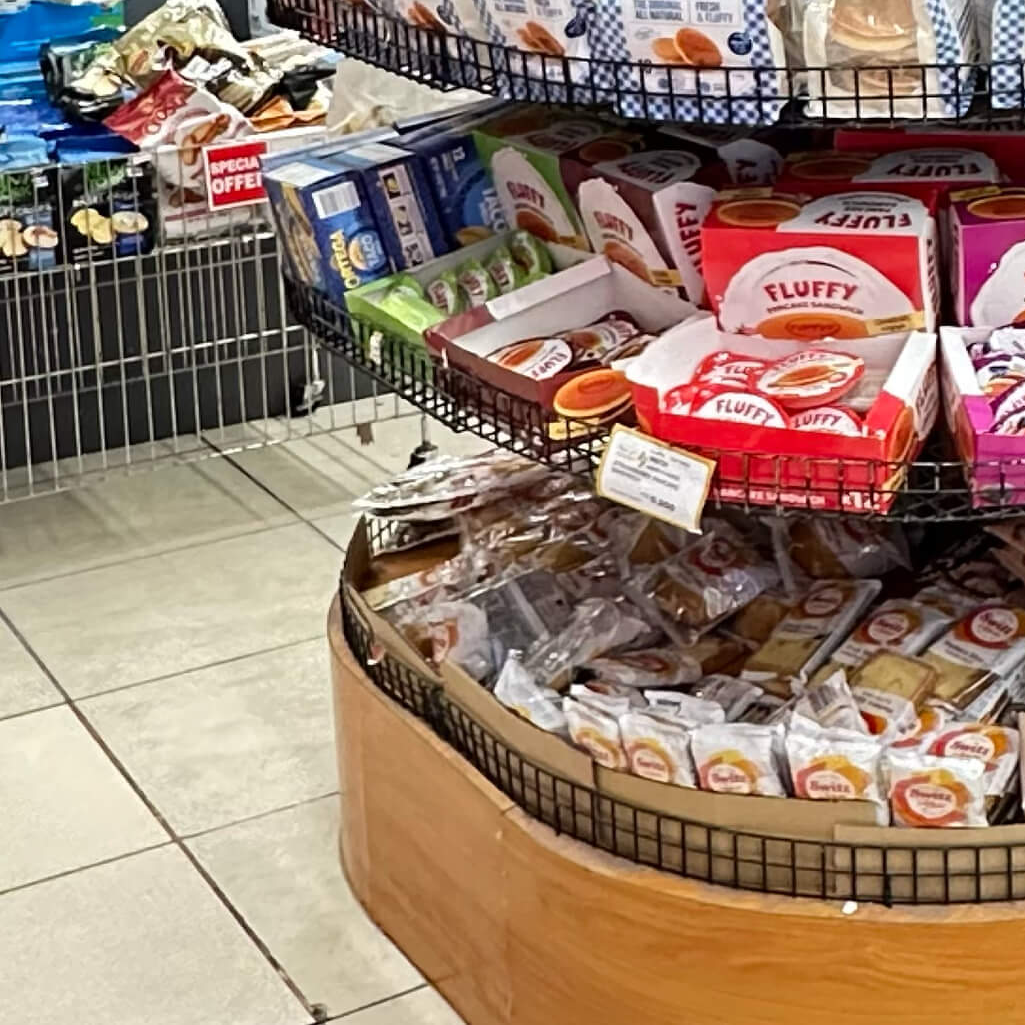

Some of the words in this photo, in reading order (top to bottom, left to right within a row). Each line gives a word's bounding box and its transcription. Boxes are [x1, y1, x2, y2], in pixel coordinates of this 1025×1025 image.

[210, 156, 260, 176] SPECIA
[886, 161, 982, 177] FLUFFY
[814, 211, 913, 232] FLUFFY
[329, 228, 361, 290] ORTEGA
[361, 234, 380, 267] TACO
[763, 280, 860, 303] FLUFFY
[766, 301, 809, 315] PANCAKE
[811, 300, 865, 316] SANDWICH
[715, 398, 775, 424] FLUFFY
[949, 743, 990, 756] Switz
